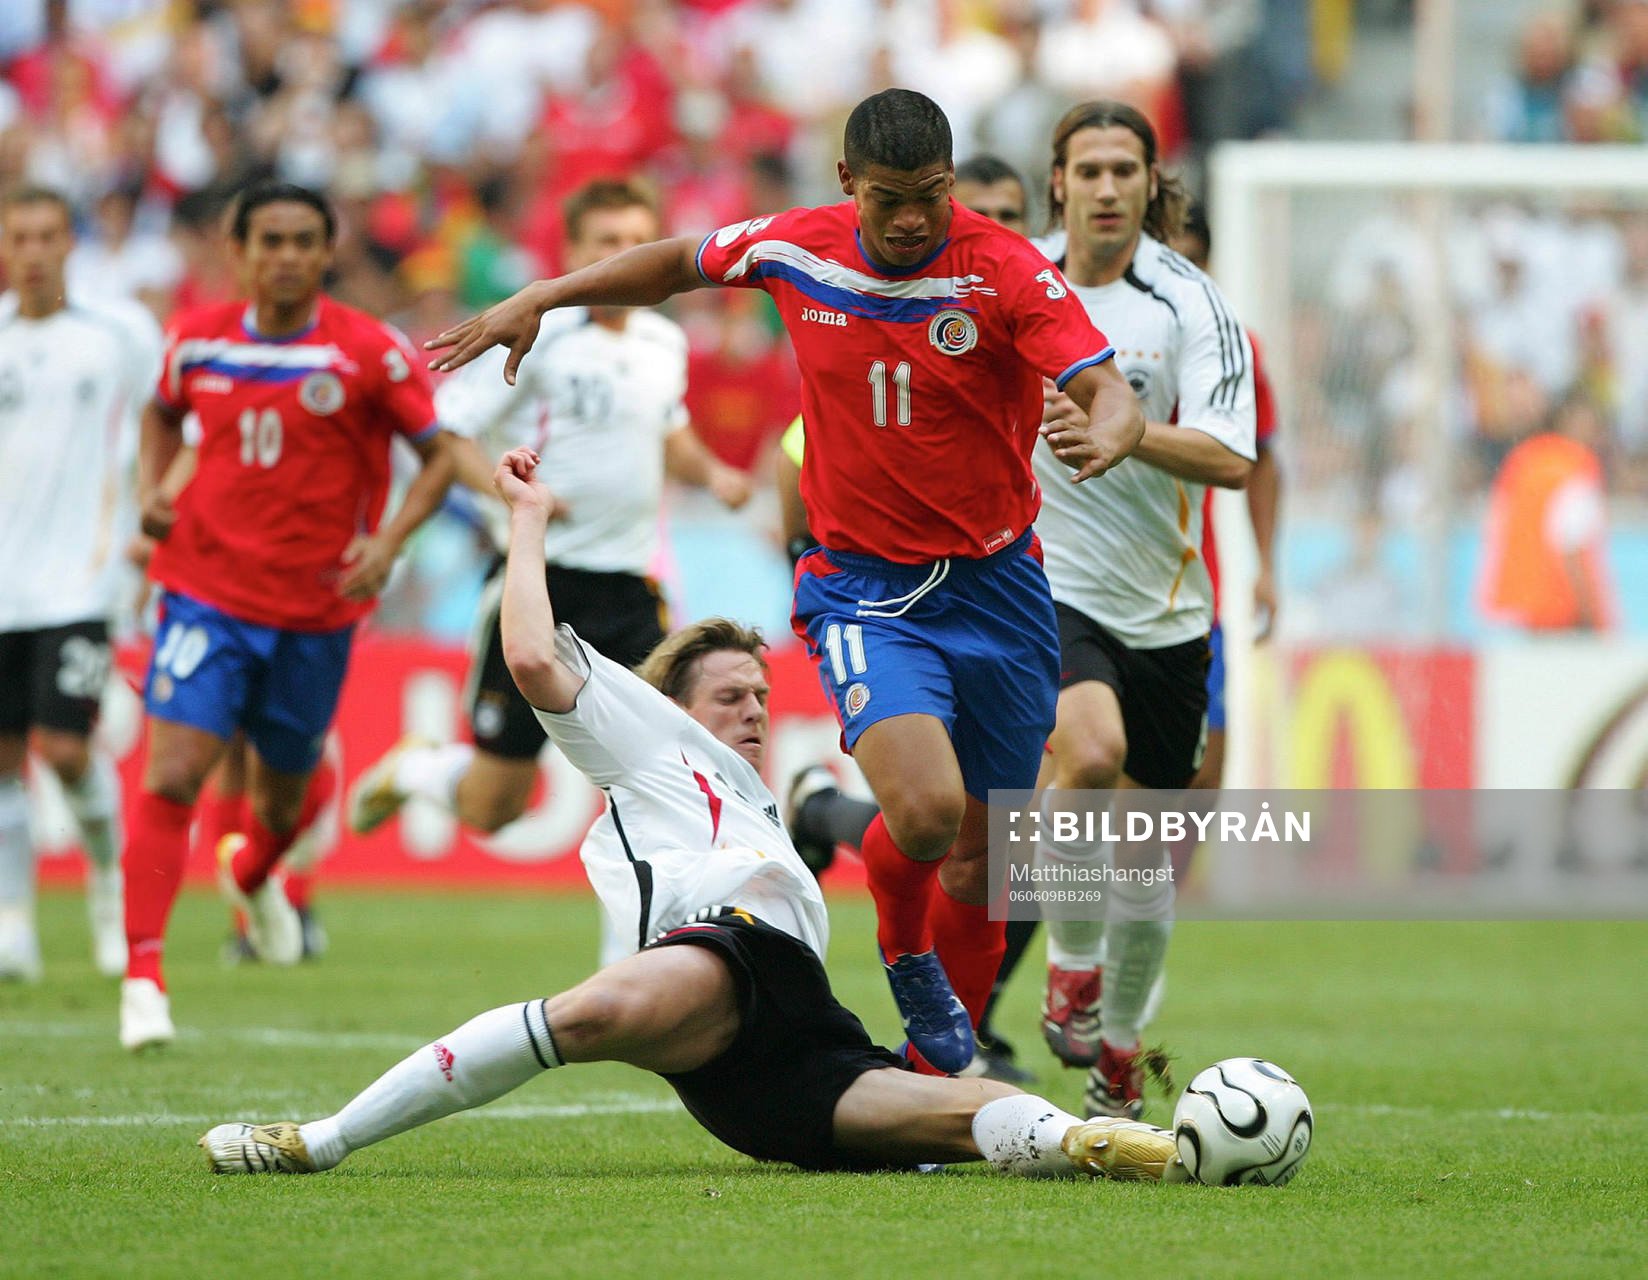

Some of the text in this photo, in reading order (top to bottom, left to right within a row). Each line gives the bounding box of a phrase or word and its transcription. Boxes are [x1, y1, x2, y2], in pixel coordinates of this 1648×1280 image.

[801, 307, 848, 327] Joma
[867, 360, 911, 427] 11
[239, 407, 283, 468] 10
[155, 623, 209, 679] 10
[825, 624, 868, 685] 11
